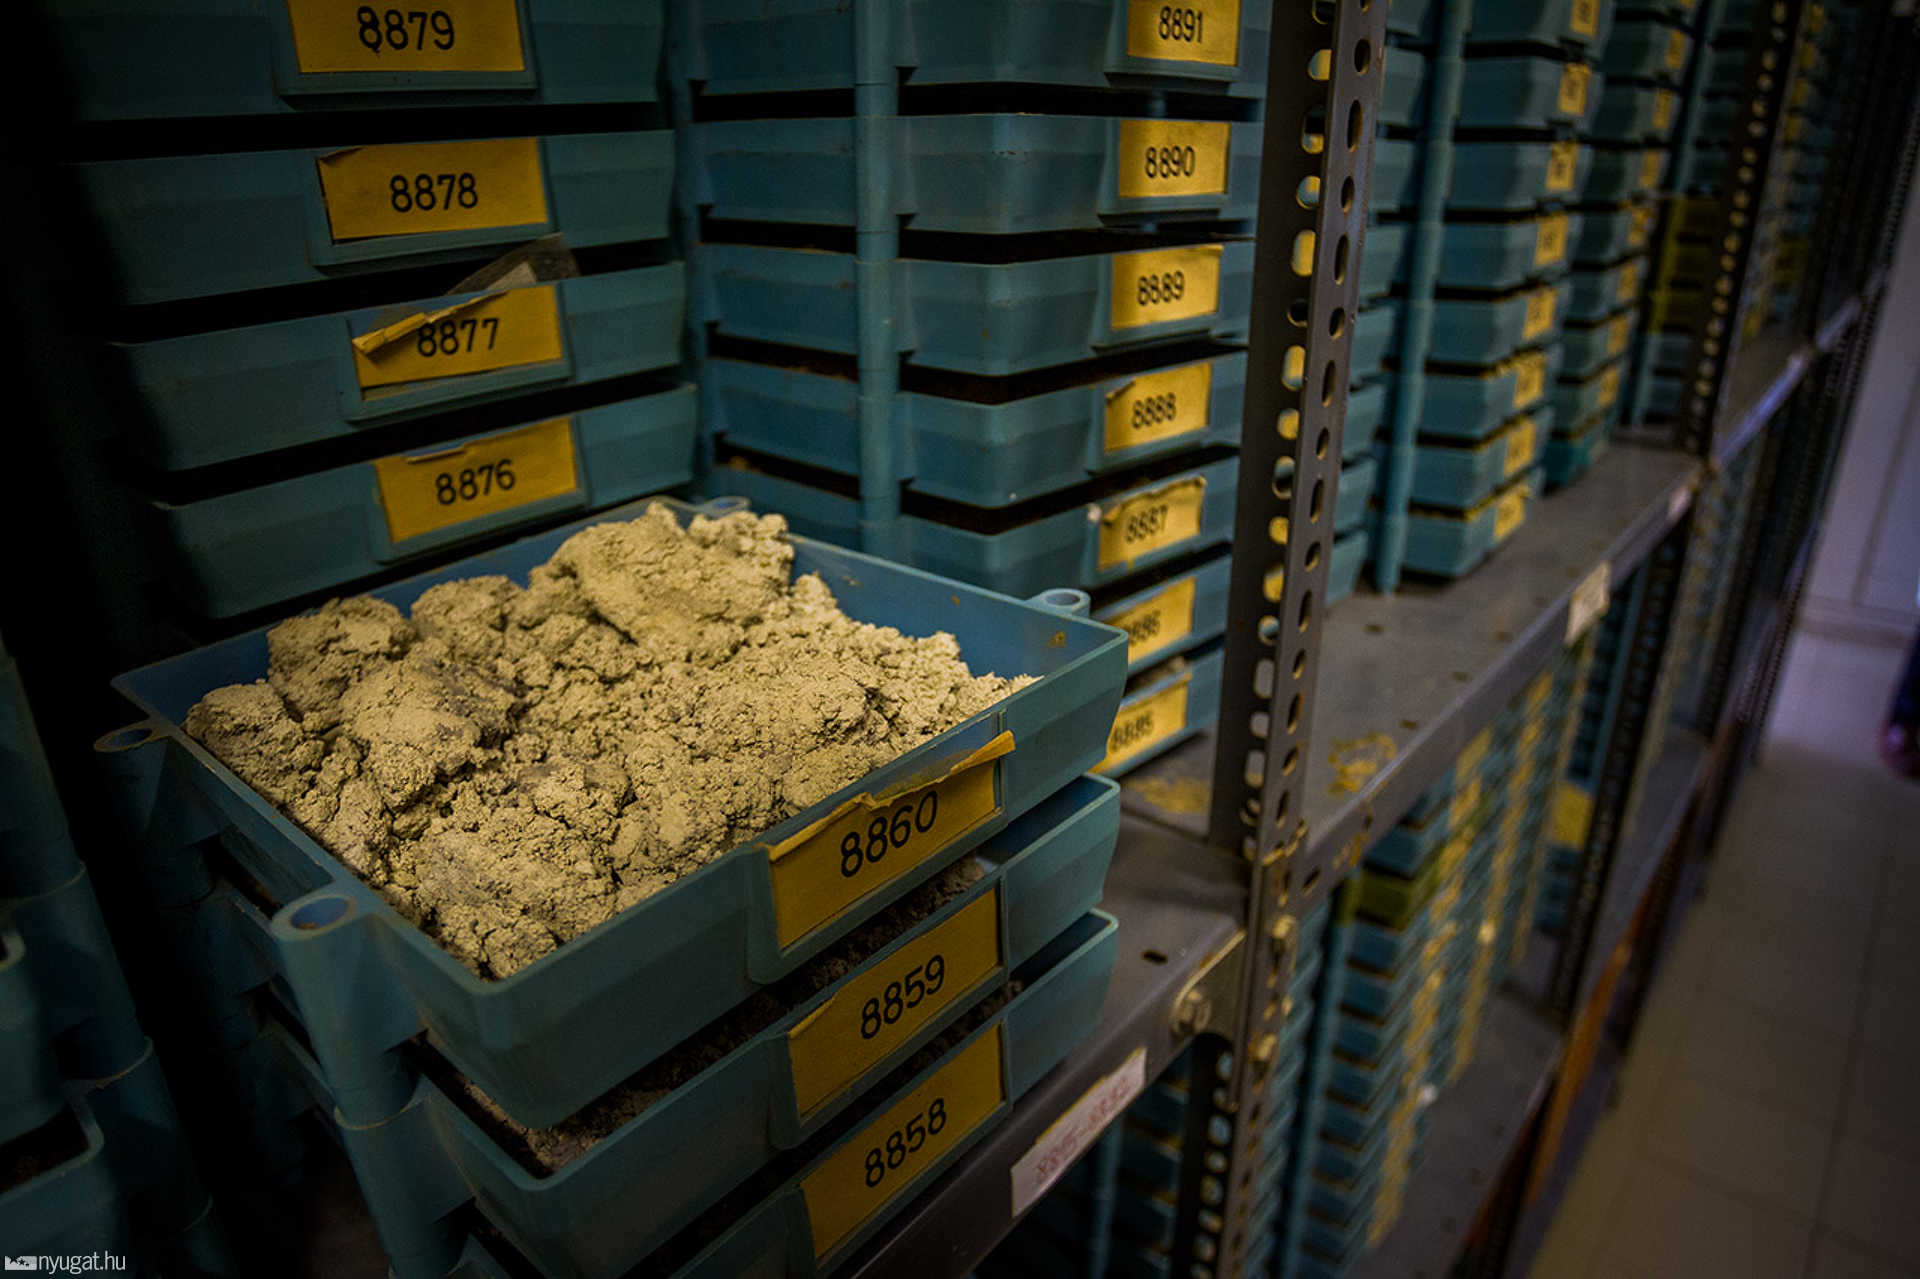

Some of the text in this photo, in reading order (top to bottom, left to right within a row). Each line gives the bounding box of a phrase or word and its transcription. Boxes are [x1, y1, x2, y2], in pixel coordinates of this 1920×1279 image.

[357, 6, 454, 51] 8879
[1158, 6, 1203, 43] 8891
[1145, 146, 1195, 178] 8890
[390, 173, 478, 212] 8878
[1137, 270, 1184, 306] 8889
[417, 318, 498, 357] 8877
[1131, 392, 1177, 429] 8888
[435, 459, 515, 505] 8876
[840, 790, 938, 878] 8860
[861, 955, 945, 1039] 8859
[865, 1098, 946, 1188] 8858
